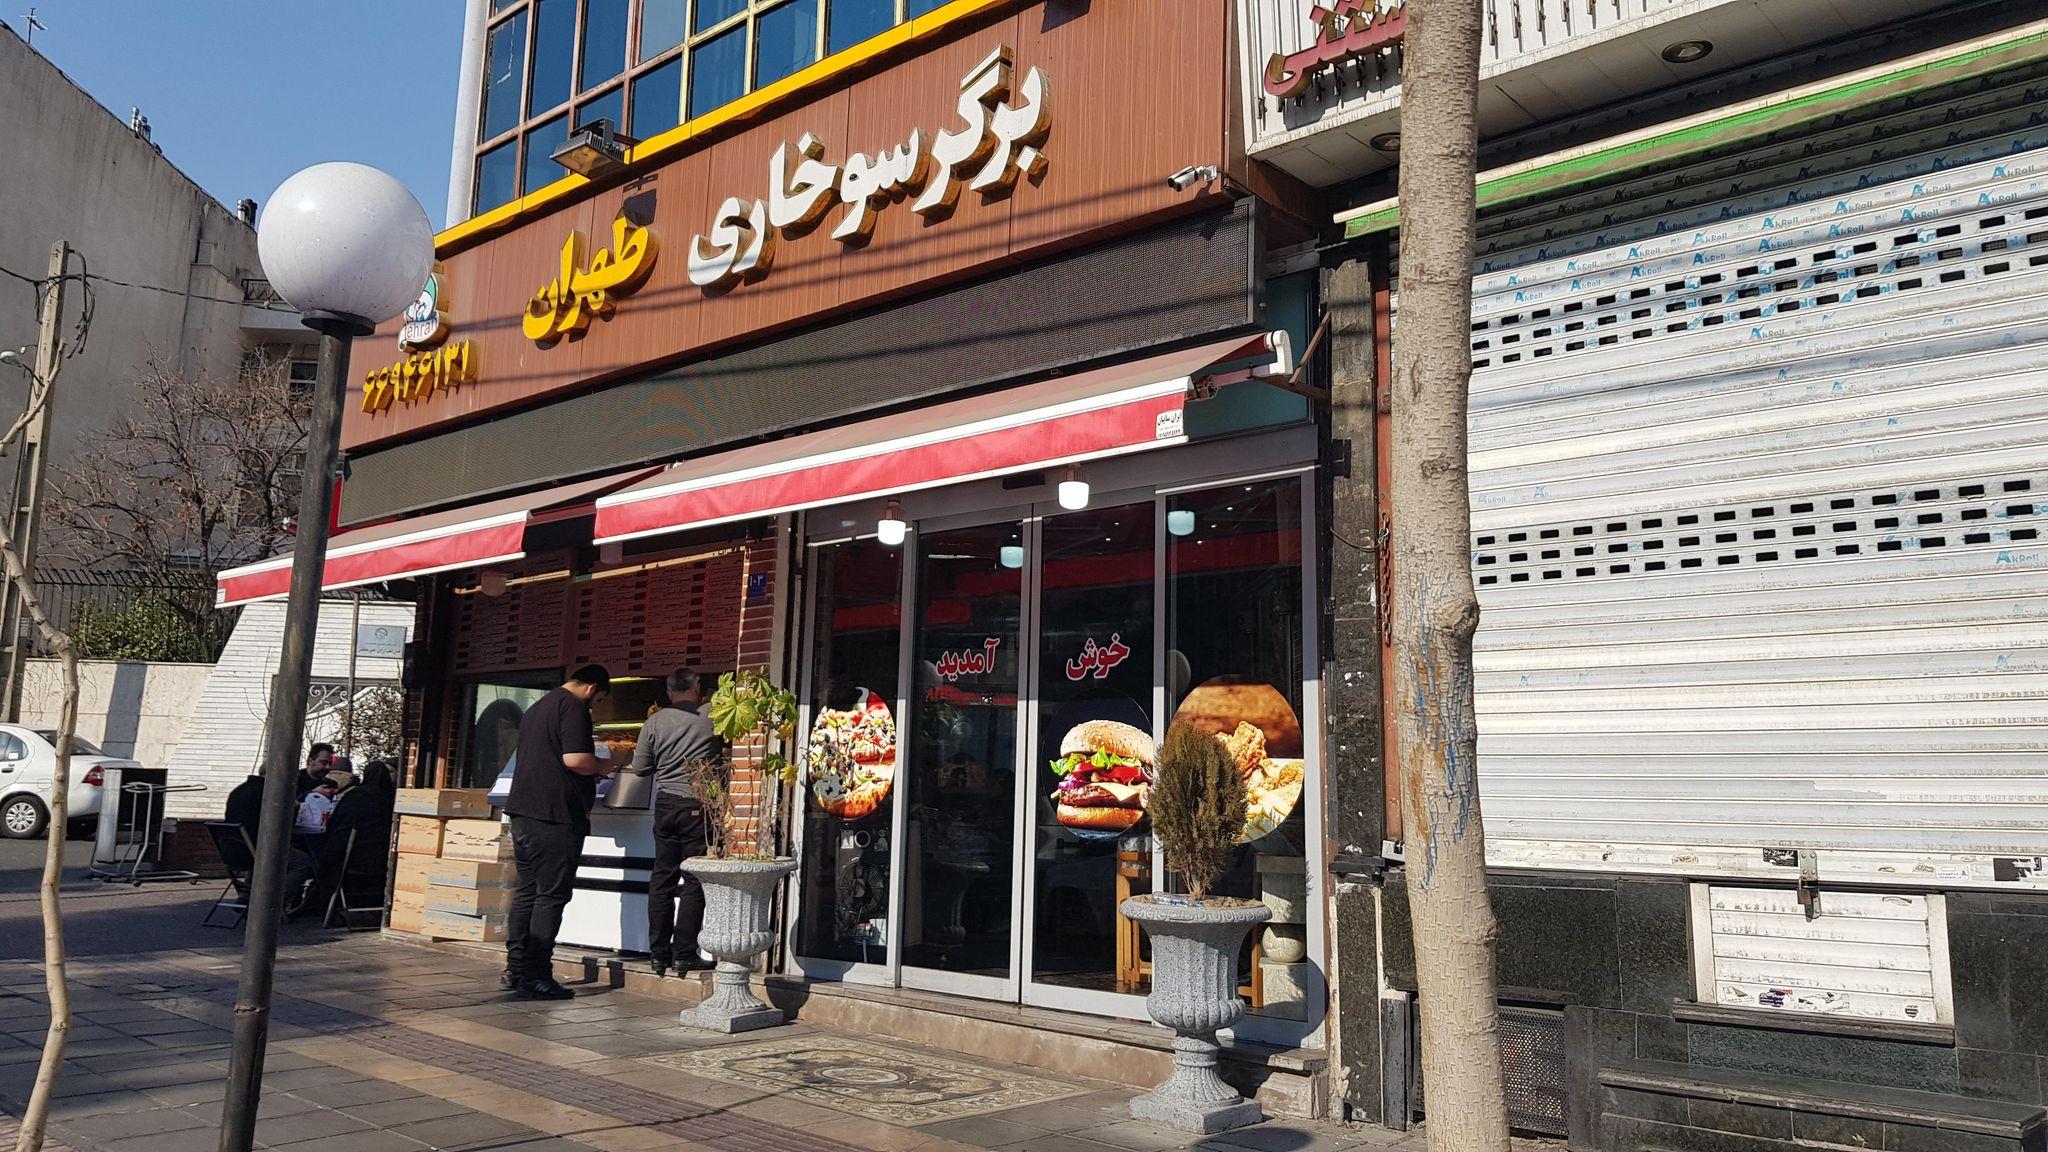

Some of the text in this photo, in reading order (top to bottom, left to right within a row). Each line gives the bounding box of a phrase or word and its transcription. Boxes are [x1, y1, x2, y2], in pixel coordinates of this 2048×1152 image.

[688, 42, 1045, 286] برگر سوخاری
[1506, 164, 2035, 287] AkRoll AkRoll AkRoll AkRoll AkRoll AkRoll AkRoll AkRoll
[1514, 290, 1543, 303] AkRoll
[1571, 278, 1600, 291] AkRoll
[1630, 264, 1661, 279] AkRoll
[1693, 251, 1725, 265] AkRoll
[1759, 237, 1793, 251] AkRoll
[1826, 221, 1864, 237] AkRoll
[1901, 205, 1939, 220] AkRoll
[1976, 189, 2017, 207] AkRoll
[1538, 245, 1567, 260] AkRoll
[1595, 234, 1625, 248] AkRoll
[1656, 218, 1687, 233] AkRoll
[1720, 204, 1753, 219] AkRoll
[522, 216, 649, 340] طهران
[362, 339, 470, 412] ۶۶۹۴۶۱۳۱
[1996, 550, 2039, 564] AkRoll
[936, 633, 1130, 681] خوش آمدید
